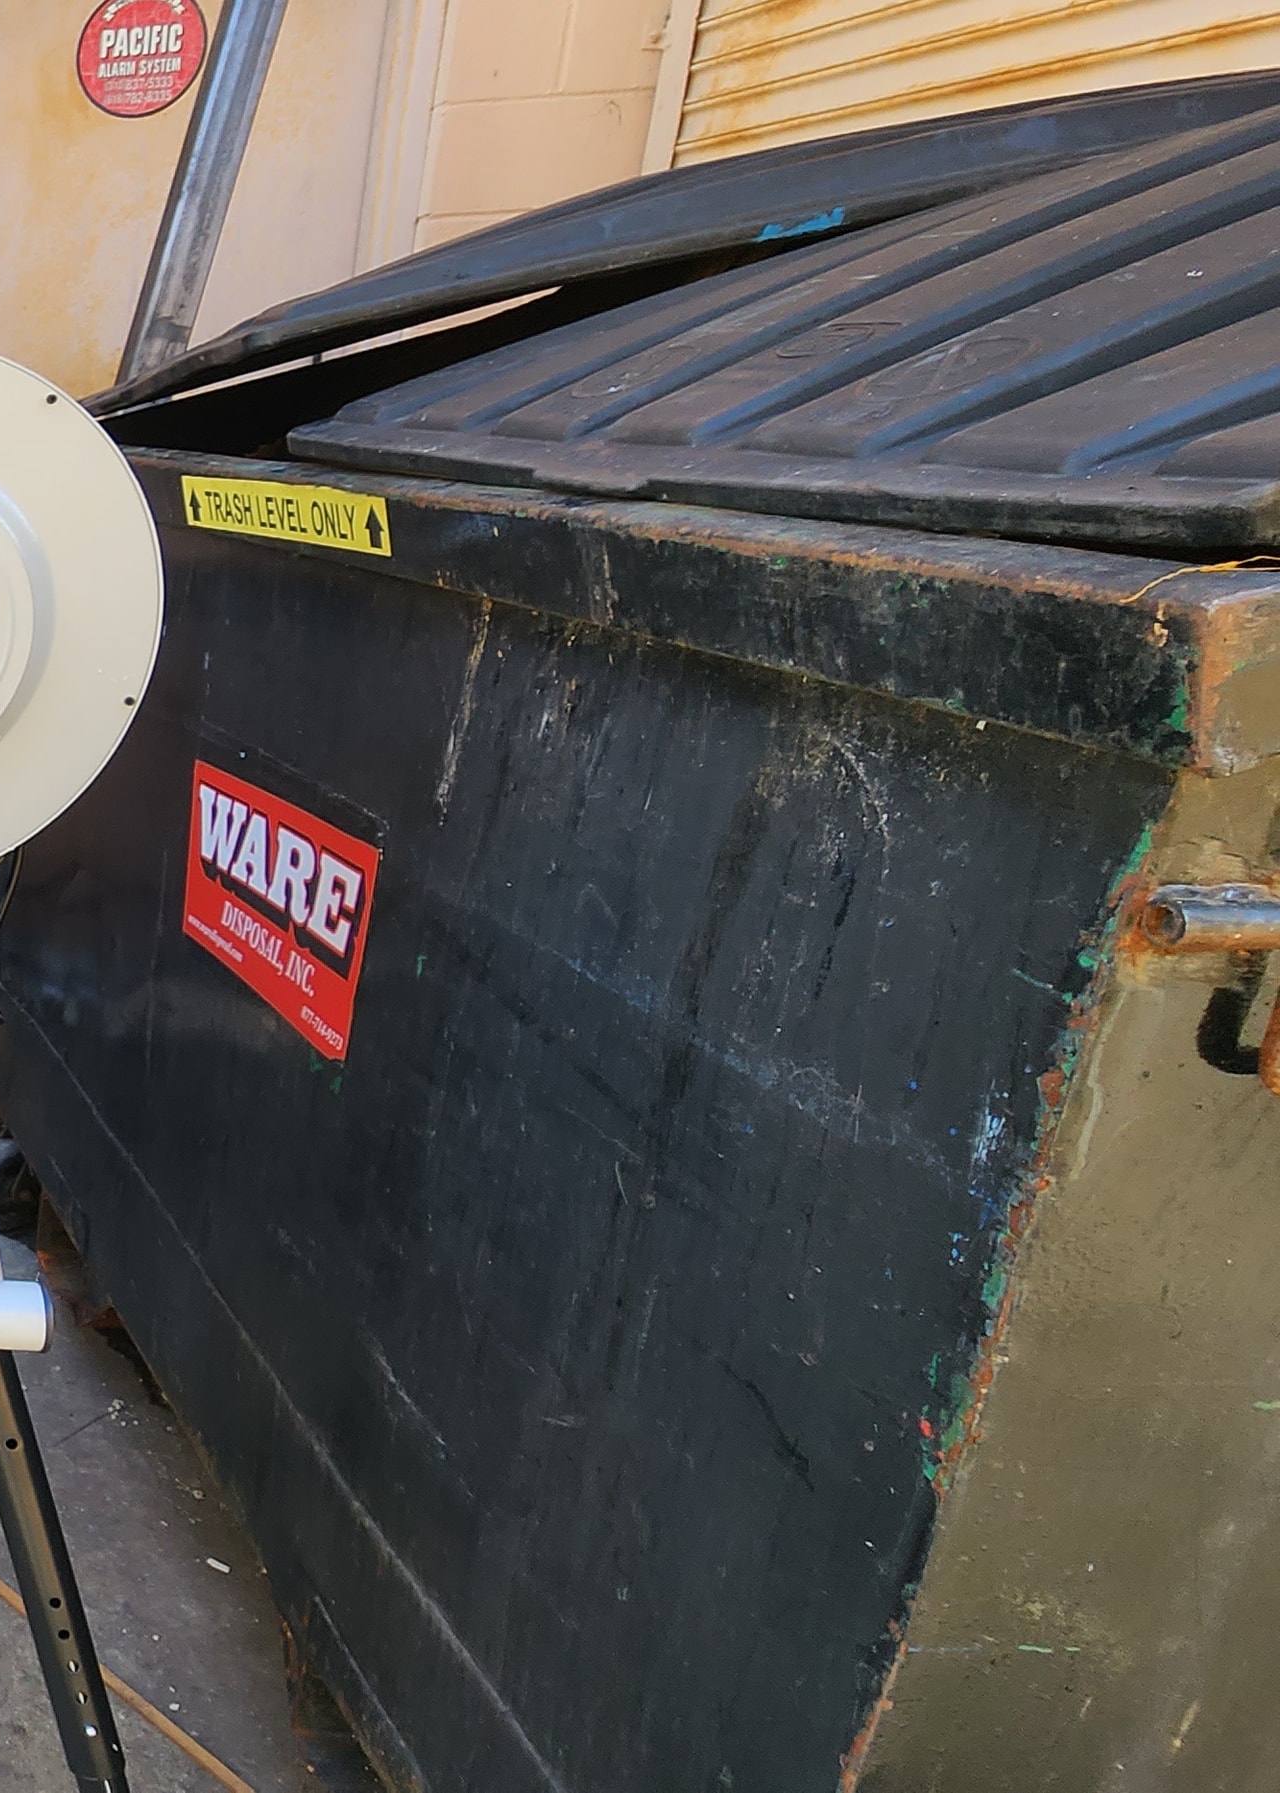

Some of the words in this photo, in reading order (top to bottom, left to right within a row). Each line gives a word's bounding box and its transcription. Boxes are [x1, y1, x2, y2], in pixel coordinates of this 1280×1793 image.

[99, 23, 183, 59] PACIFIC
[98, 61, 136, 78] ALARM
[139, 57, 181, 76] SYSTEM
[205, 490, 254, 526] TRASH
[256, 495, 307, 533] LEVEL
[310, 501, 355, 540] ONLY
[199, 783, 364, 957] WARE
[220, 900, 284, 976] DISPOSAL,
[285, 950, 316, 998] INC.
